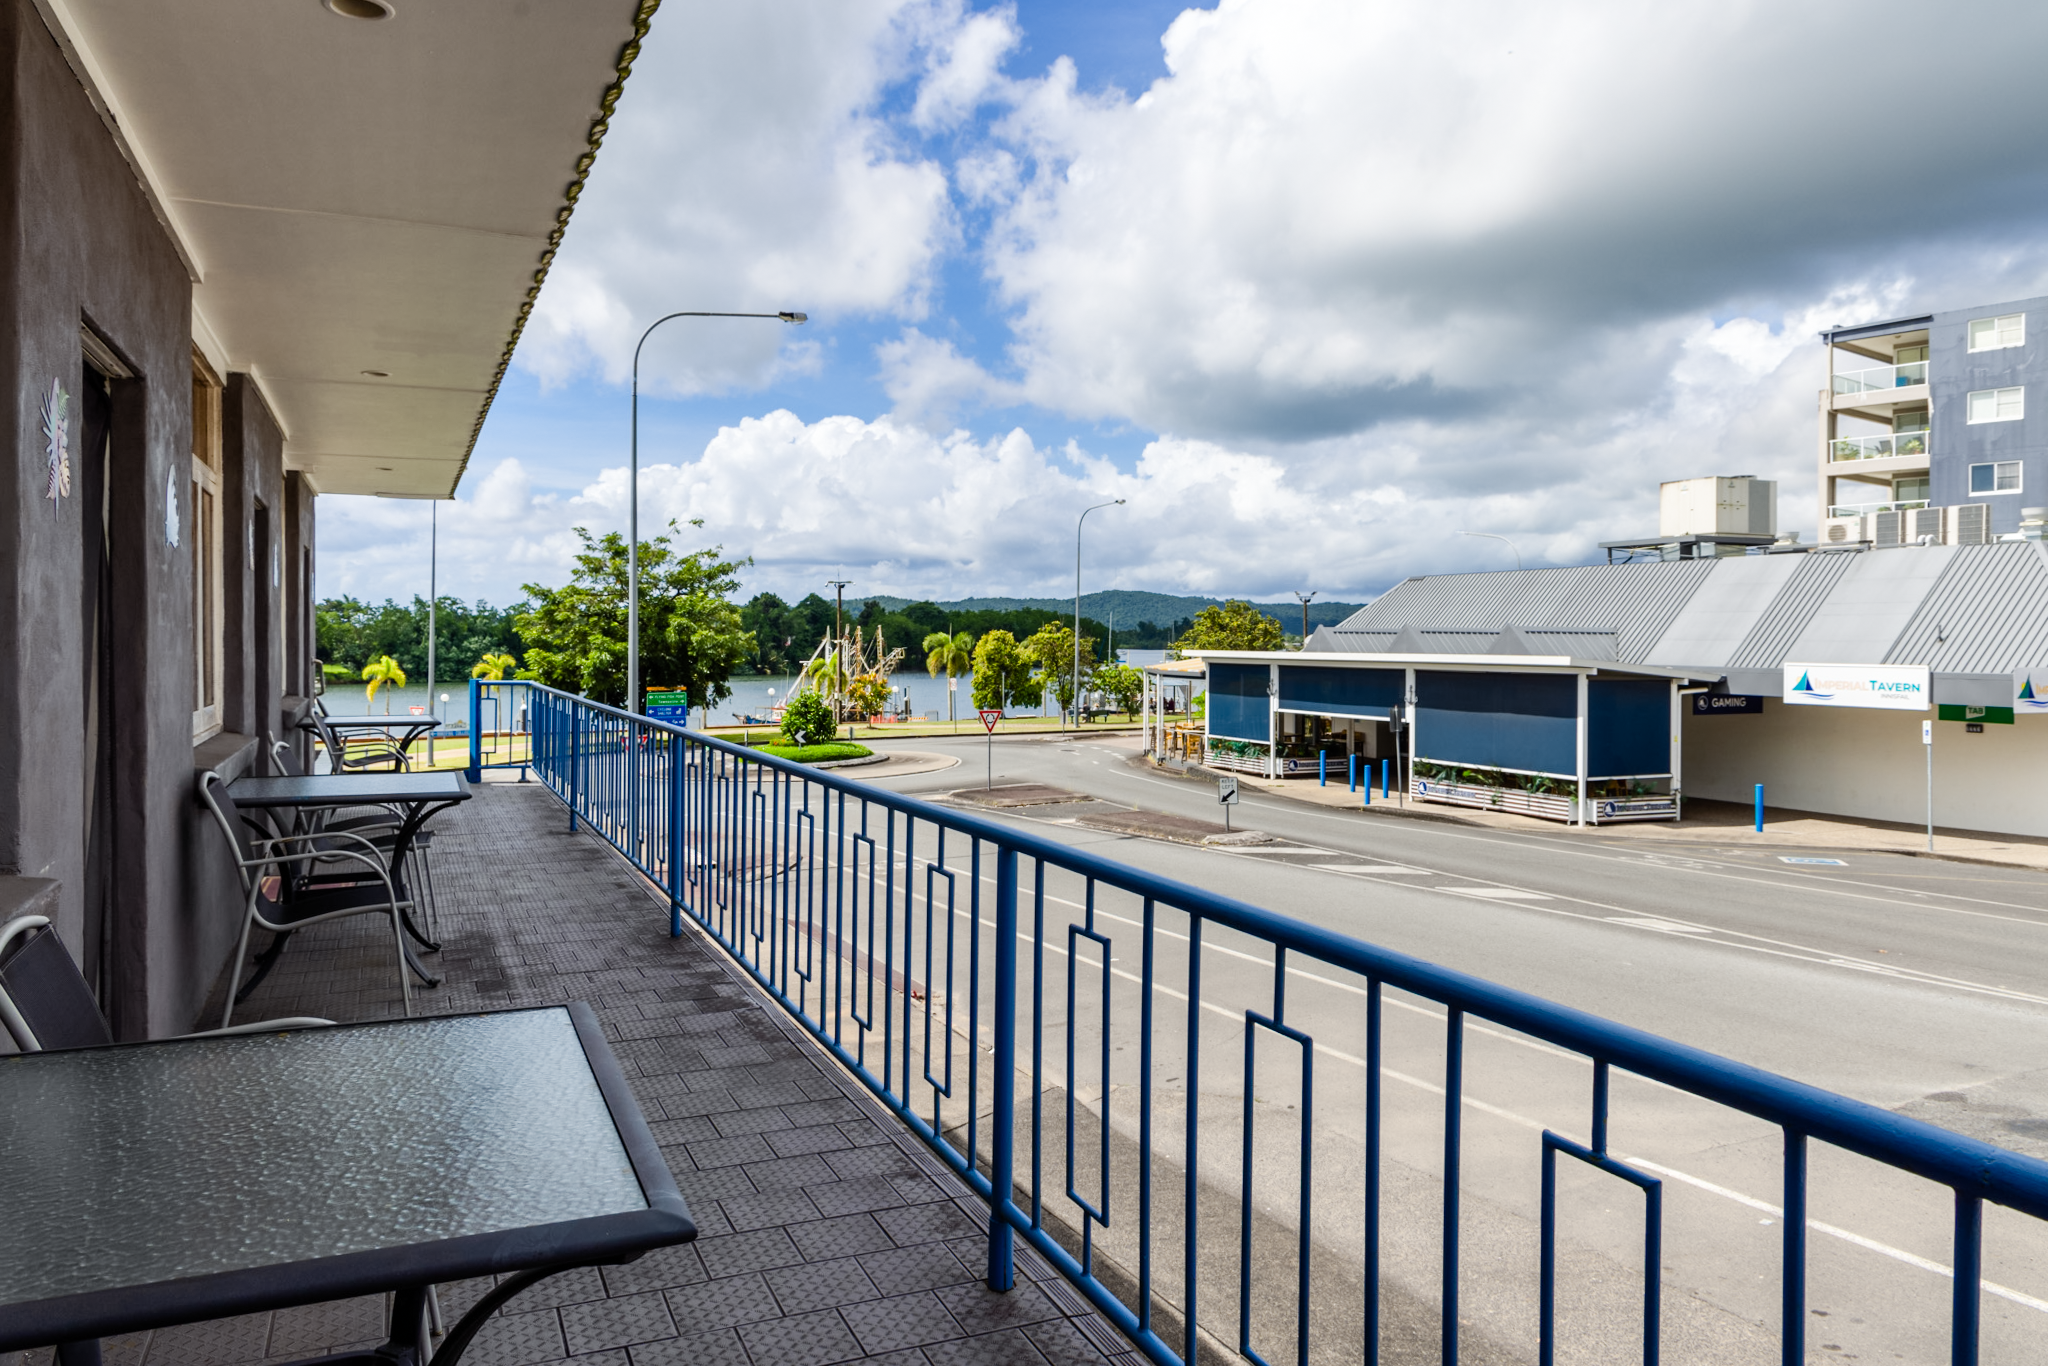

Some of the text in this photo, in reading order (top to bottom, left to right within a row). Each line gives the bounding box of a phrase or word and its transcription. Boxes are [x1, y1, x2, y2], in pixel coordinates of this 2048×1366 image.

[1814, 678, 1921, 693] IMPERIAL TAVERN
[1711, 697, 1747, 707] GAMING
